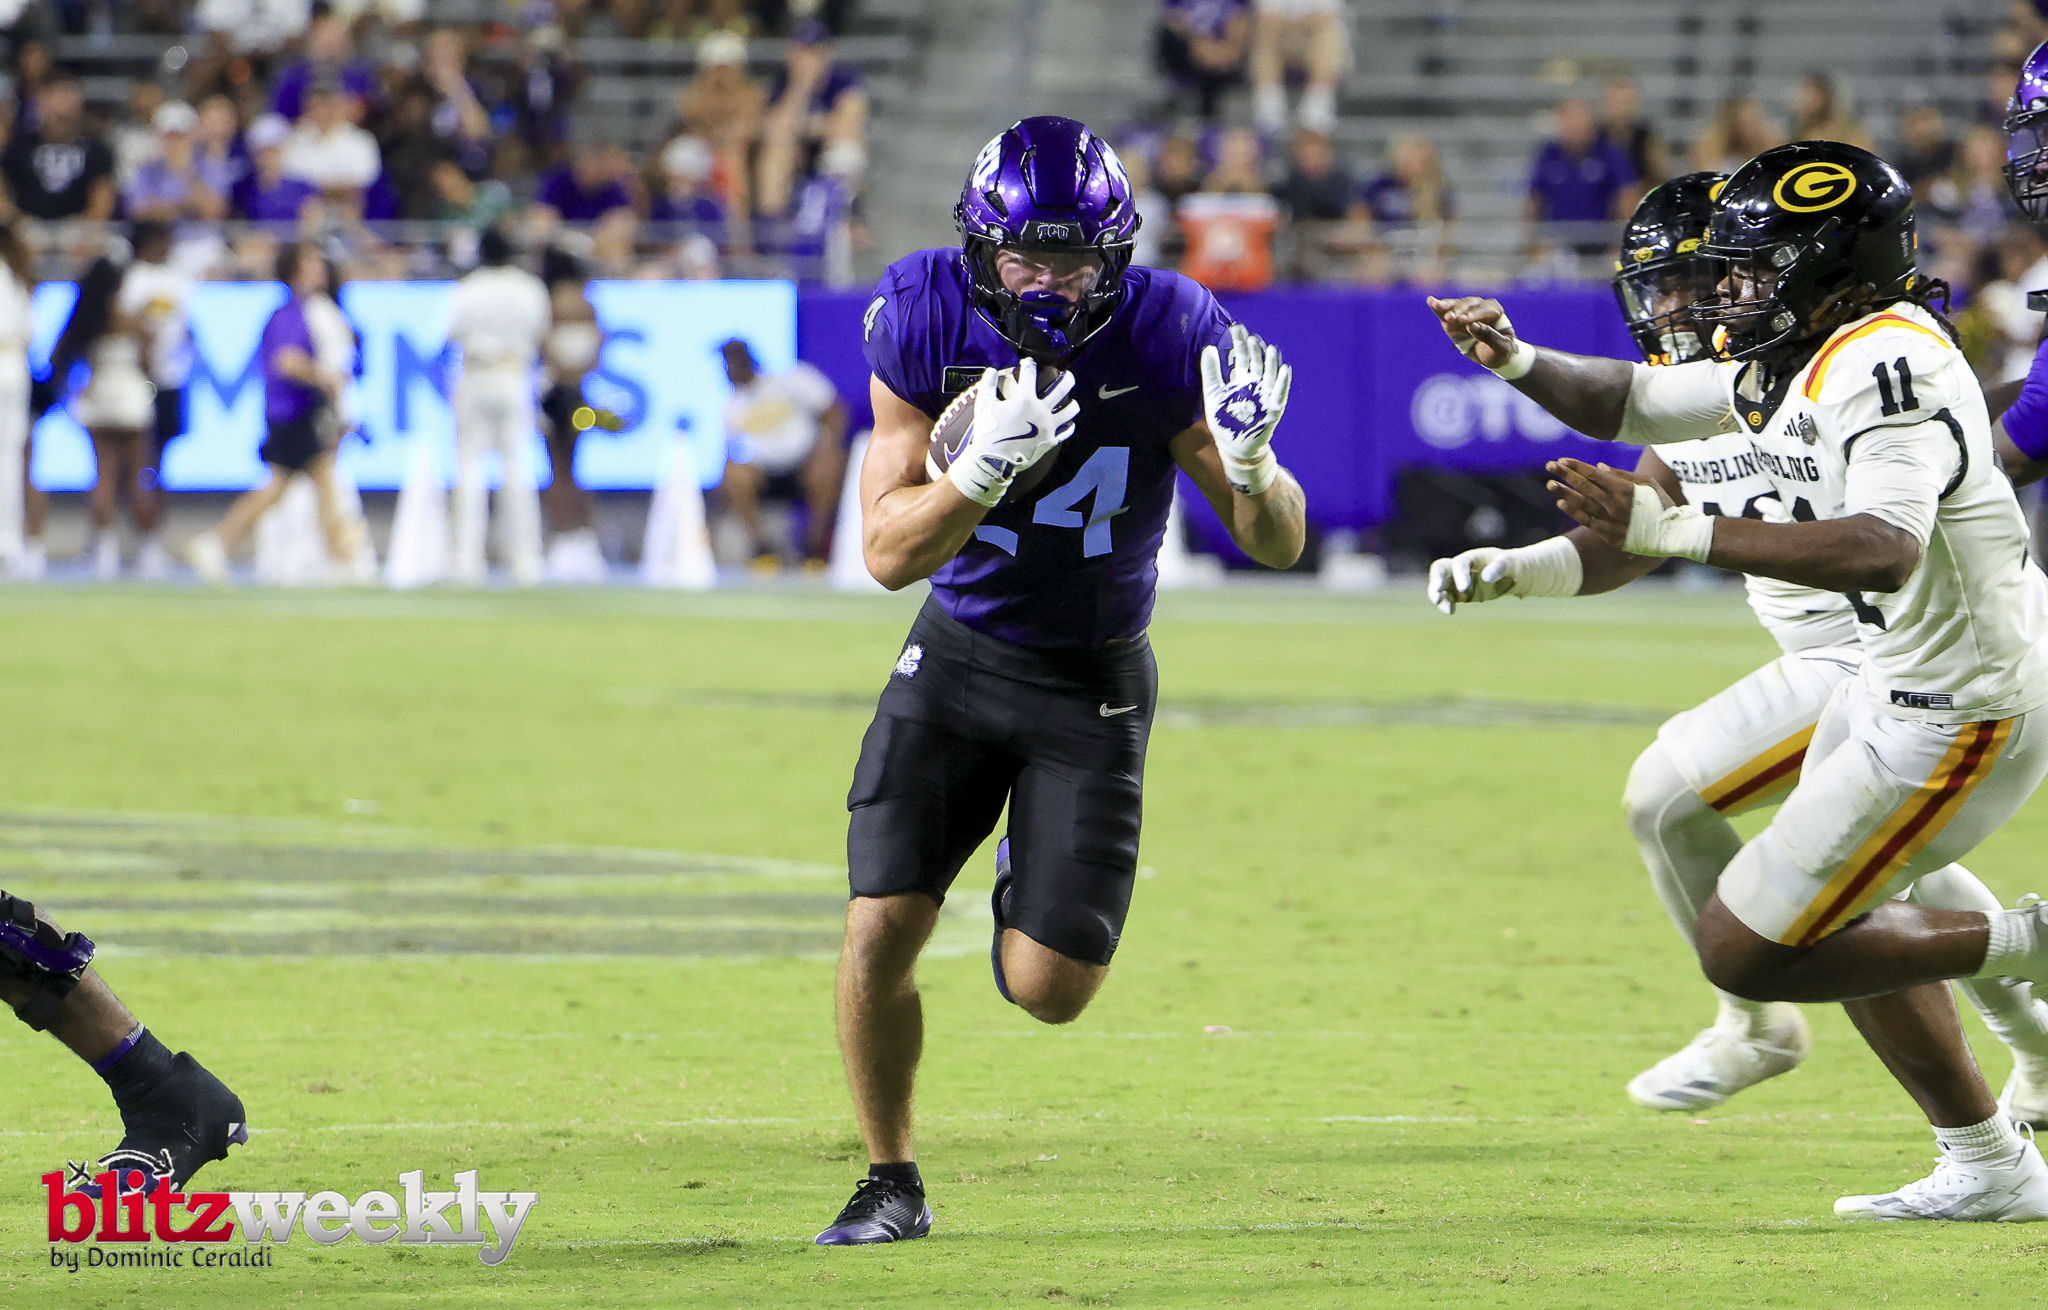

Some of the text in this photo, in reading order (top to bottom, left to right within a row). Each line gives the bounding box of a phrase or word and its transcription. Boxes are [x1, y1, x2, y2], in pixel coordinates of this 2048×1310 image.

[1773, 162, 1857, 213] G
[1037, 224, 1070, 240] TCU
[1872, 357, 1920, 417] 11
[1672, 452, 1760, 484] GRAMBLIN
[973, 446, 1130, 558] 4
